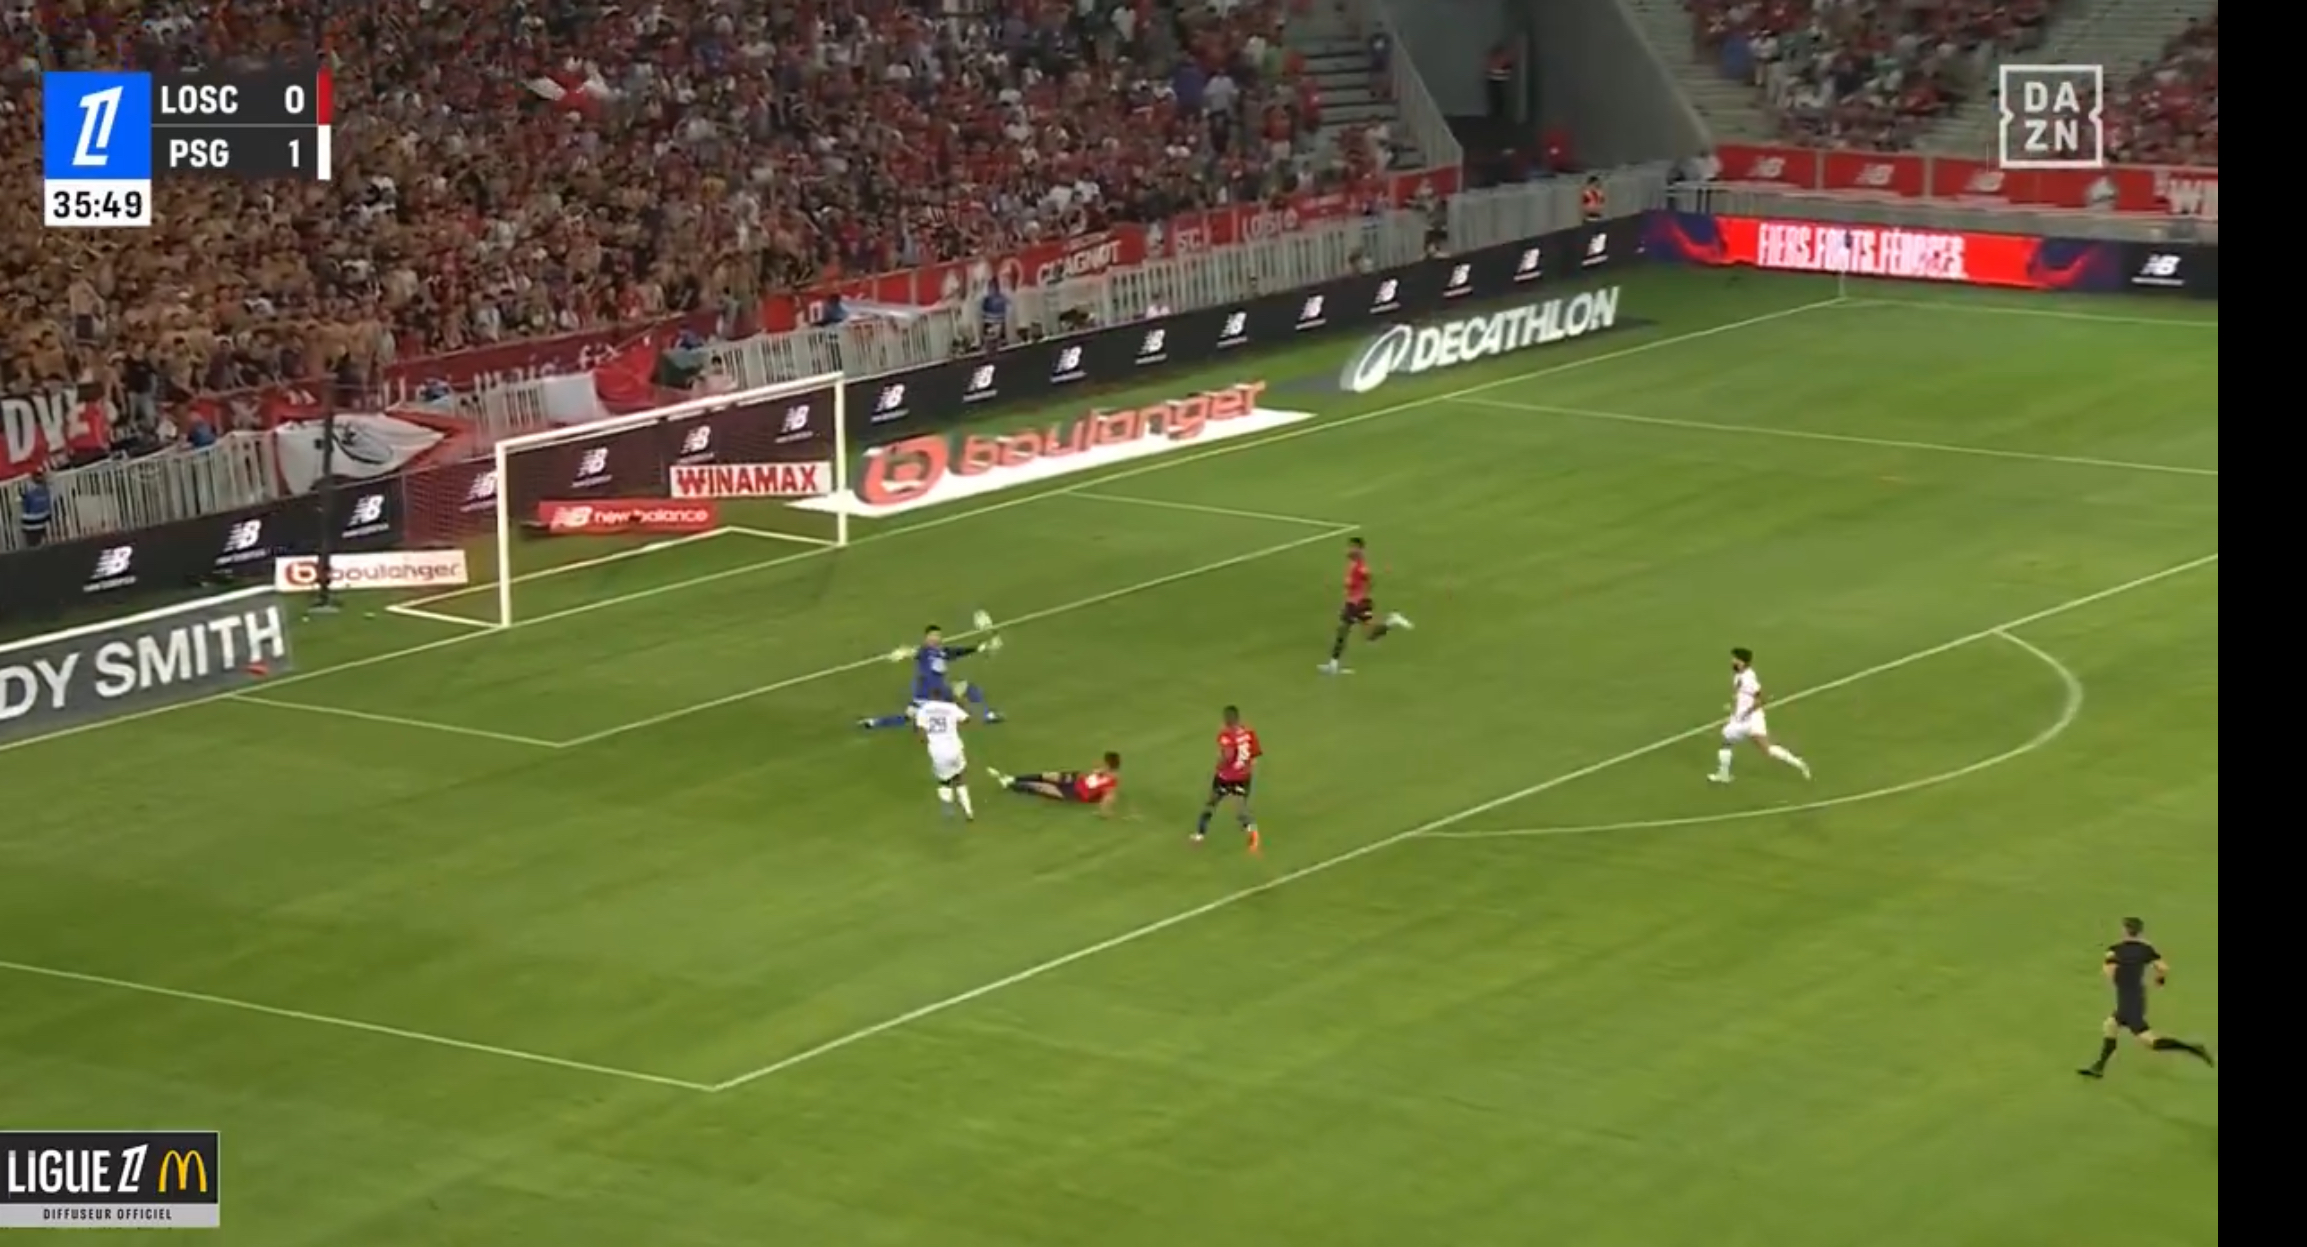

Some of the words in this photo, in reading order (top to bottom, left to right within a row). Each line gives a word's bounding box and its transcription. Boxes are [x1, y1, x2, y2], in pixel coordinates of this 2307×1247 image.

[1410, 286, 1620, 373] DECATHLON
[953, 380, 1266, 475] boulanger
[676, 466, 817, 495] WINAMAX
[0, 652, 81, 720] DY
[95, 606, 284, 697] SMITH
